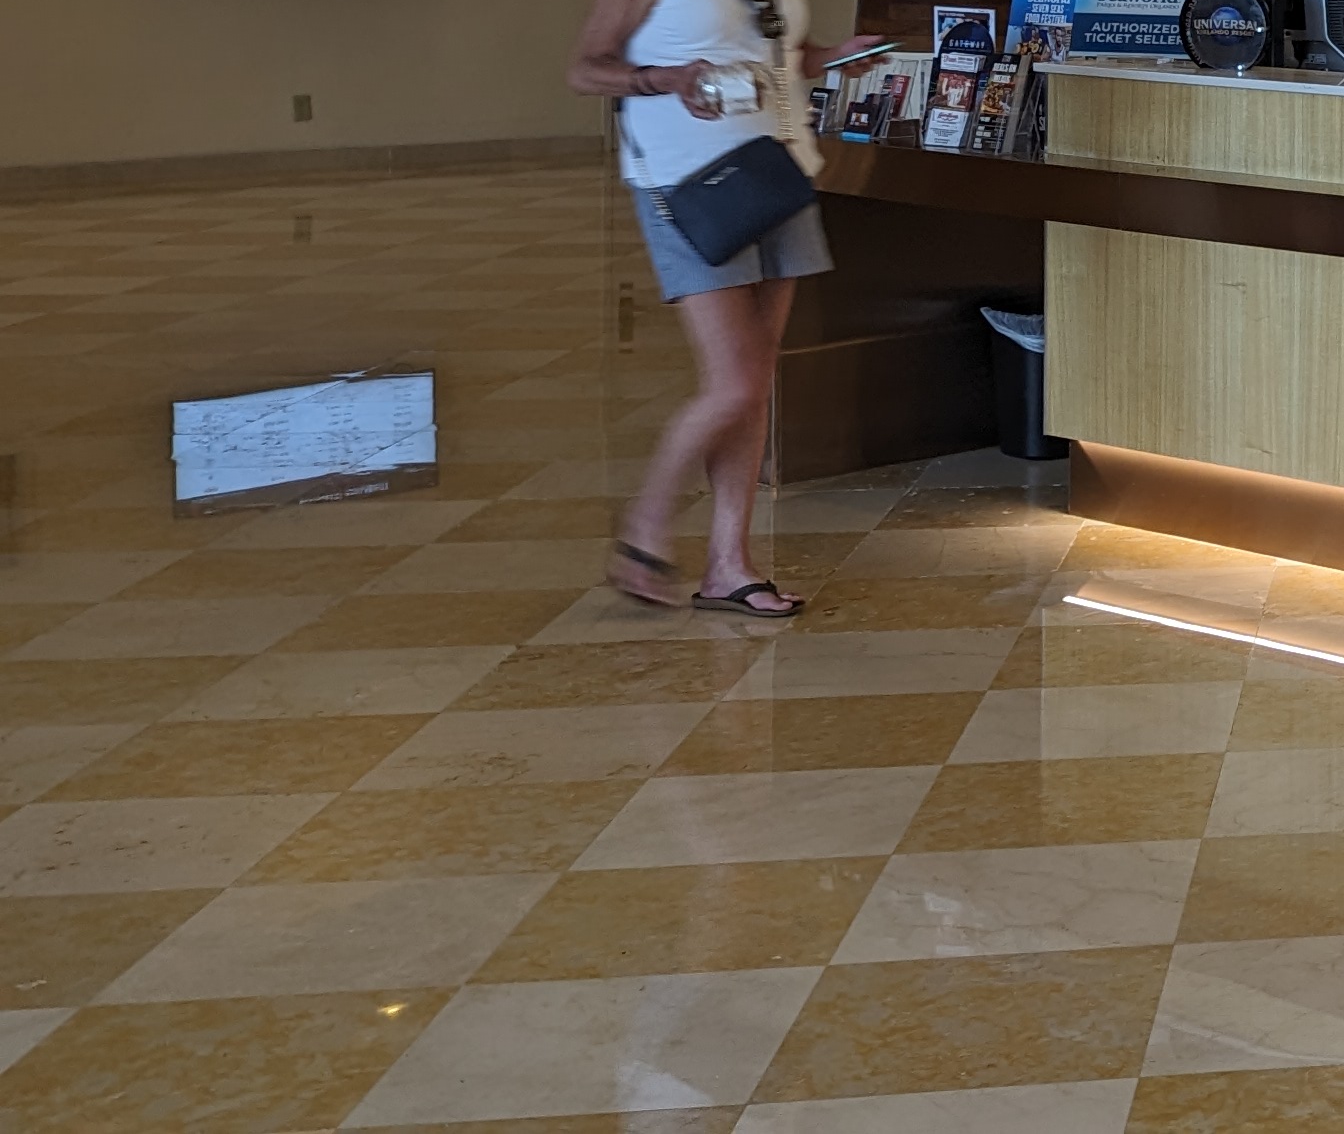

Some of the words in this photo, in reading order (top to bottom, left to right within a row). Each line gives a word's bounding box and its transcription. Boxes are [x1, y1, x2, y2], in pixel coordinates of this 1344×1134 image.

[1091, 22, 1180, 34] AUTHORIZED
[1193, 18, 1259, 31] UNIVERSAL
[1085, 32, 1131, 43] TICKET
[1135, 34, 1183, 46] SELLER
